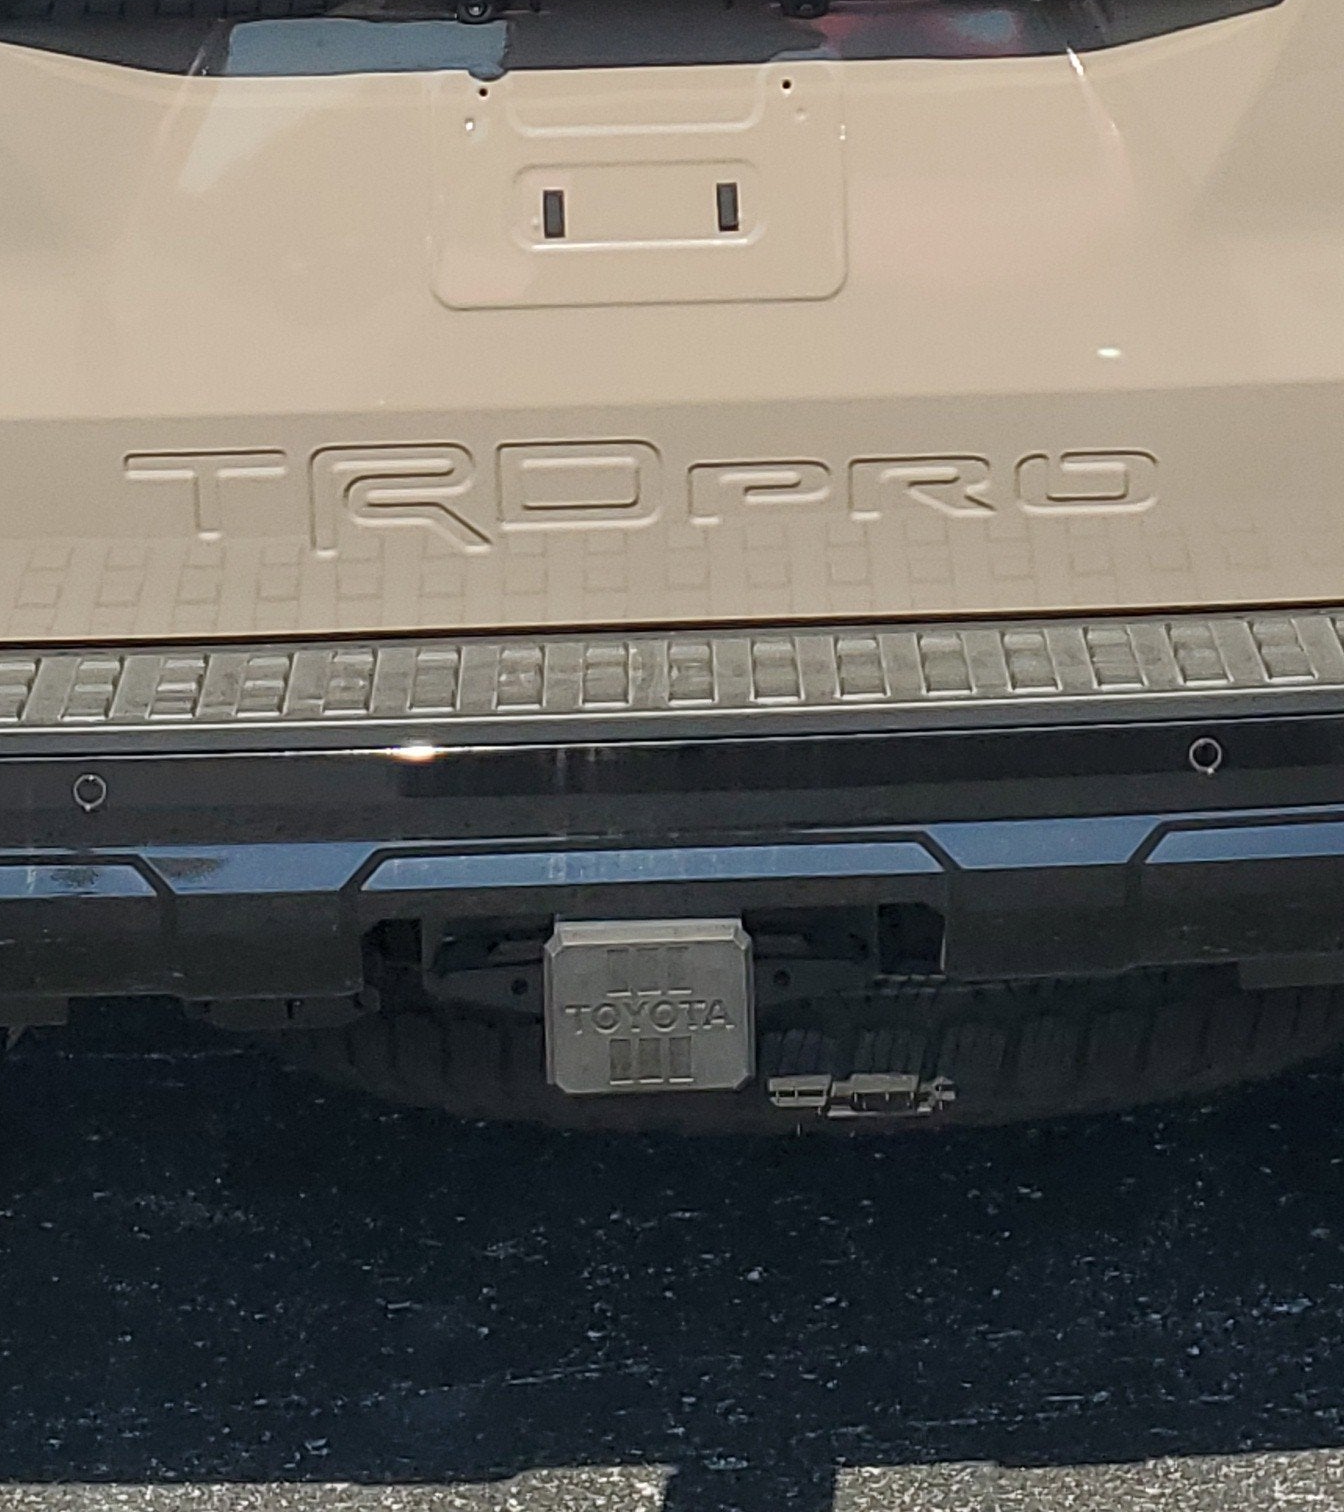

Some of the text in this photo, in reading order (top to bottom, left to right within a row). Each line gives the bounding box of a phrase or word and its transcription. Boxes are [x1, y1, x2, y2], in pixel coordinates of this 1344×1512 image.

[122, 438, 1160, 557] TRD PRO
[564, 998, 737, 1036] TOYOTA
